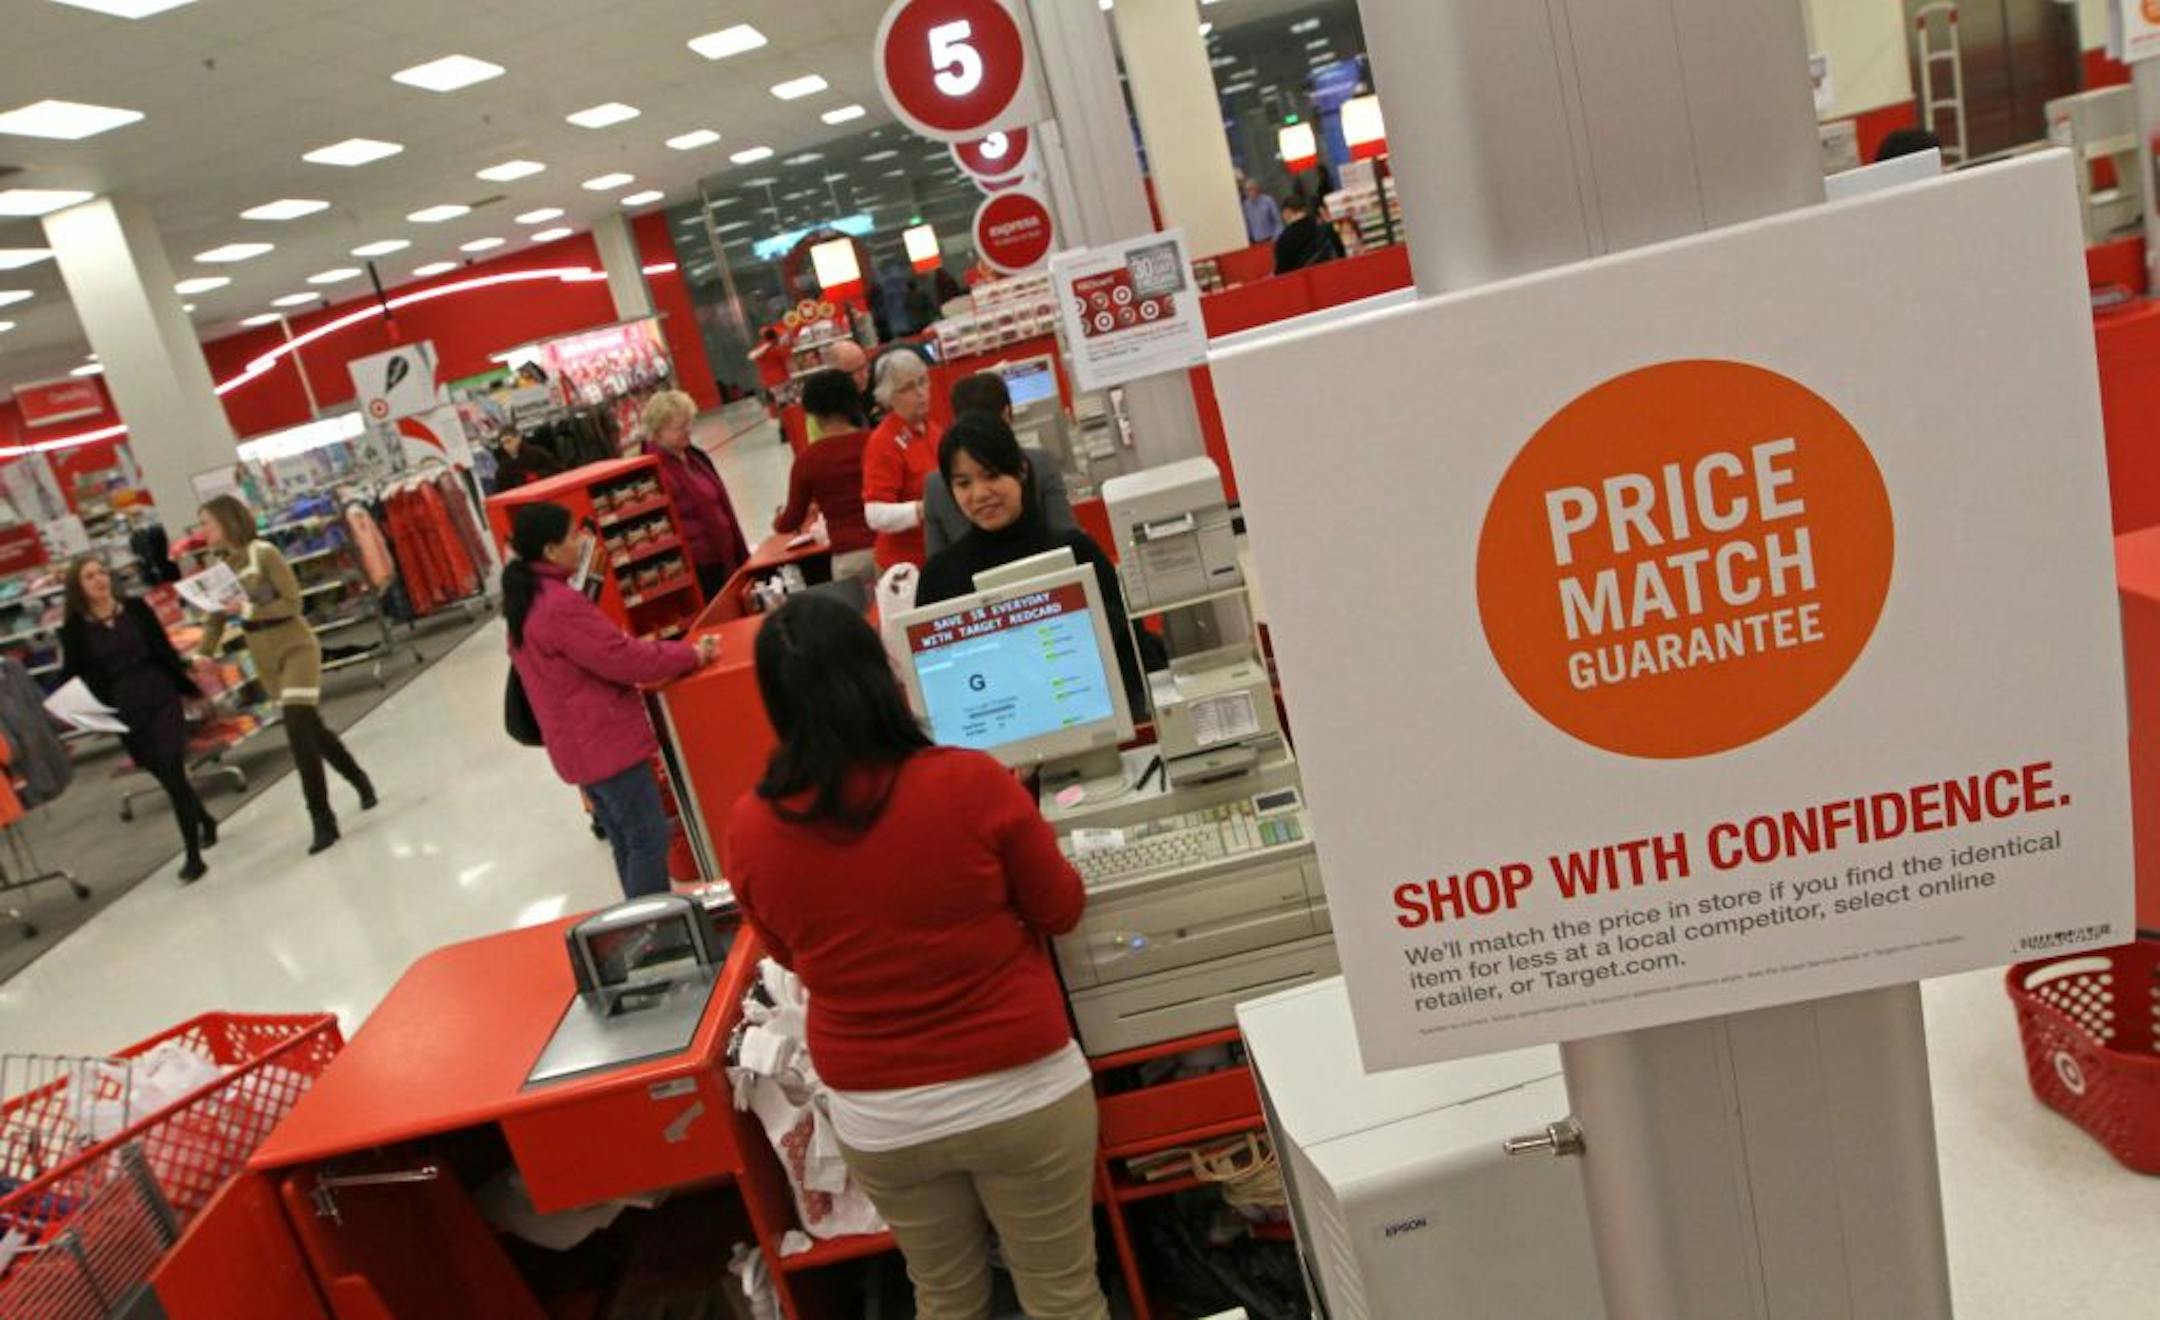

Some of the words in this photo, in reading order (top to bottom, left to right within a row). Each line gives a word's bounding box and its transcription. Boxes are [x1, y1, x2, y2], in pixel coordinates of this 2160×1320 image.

[929, 20, 982, 95] 5
[1545, 438, 1804, 565] PRICE
[921, 630, 954, 647] WITH
[960, 618, 1003, 638] TARGET
[1009, 602, 1063, 625] REDCARD
[933, 613, 963, 632] SAVE
[991, 592, 1050, 615] EVERYDAY
[1560, 528, 1815, 640] MATCH
[969, 674, 986, 691] G
[1569, 603, 1824, 690] GUARANTEE
[1393, 860, 1533, 929] SHOP
[1548, 831, 1691, 900] WITH
[1707, 762, 2071, 871] CONFIDENCE.
[1405, 940, 1462, 965] We'll
[1469, 927, 1545, 955] match
[1553, 920, 1591, 940] the
[1599, 908, 1662, 936] price
[1669, 901, 1690, 920] in
[1698, 889, 1762, 915] store
[1770, 880, 1784, 901] if
[1792, 876, 1838, 901] you
[1846, 861, 1894, 887] find
[1901, 855, 1943, 877] the
[1951, 830, 2061, 868] identical
[1410, 970, 1463, 990] item
[1469, 960, 1502, 979] for
[1509, 949, 1558, 972] less
[1565, 943, 1589, 962] at
[1596, 942, 1612, 956] a
[1618, 926, 1677, 952] local
[1684, 902, 1826, 940] competitor,
[1833, 884, 1910, 914] select
[1918, 872, 1996, 898] online
[1414, 985, 1503, 1013] retailer,
[1510, 979, 1535, 995] or
[1539, 953, 1687, 988] Target.com.
[1385, 1218, 1427, 1237] EPSON
